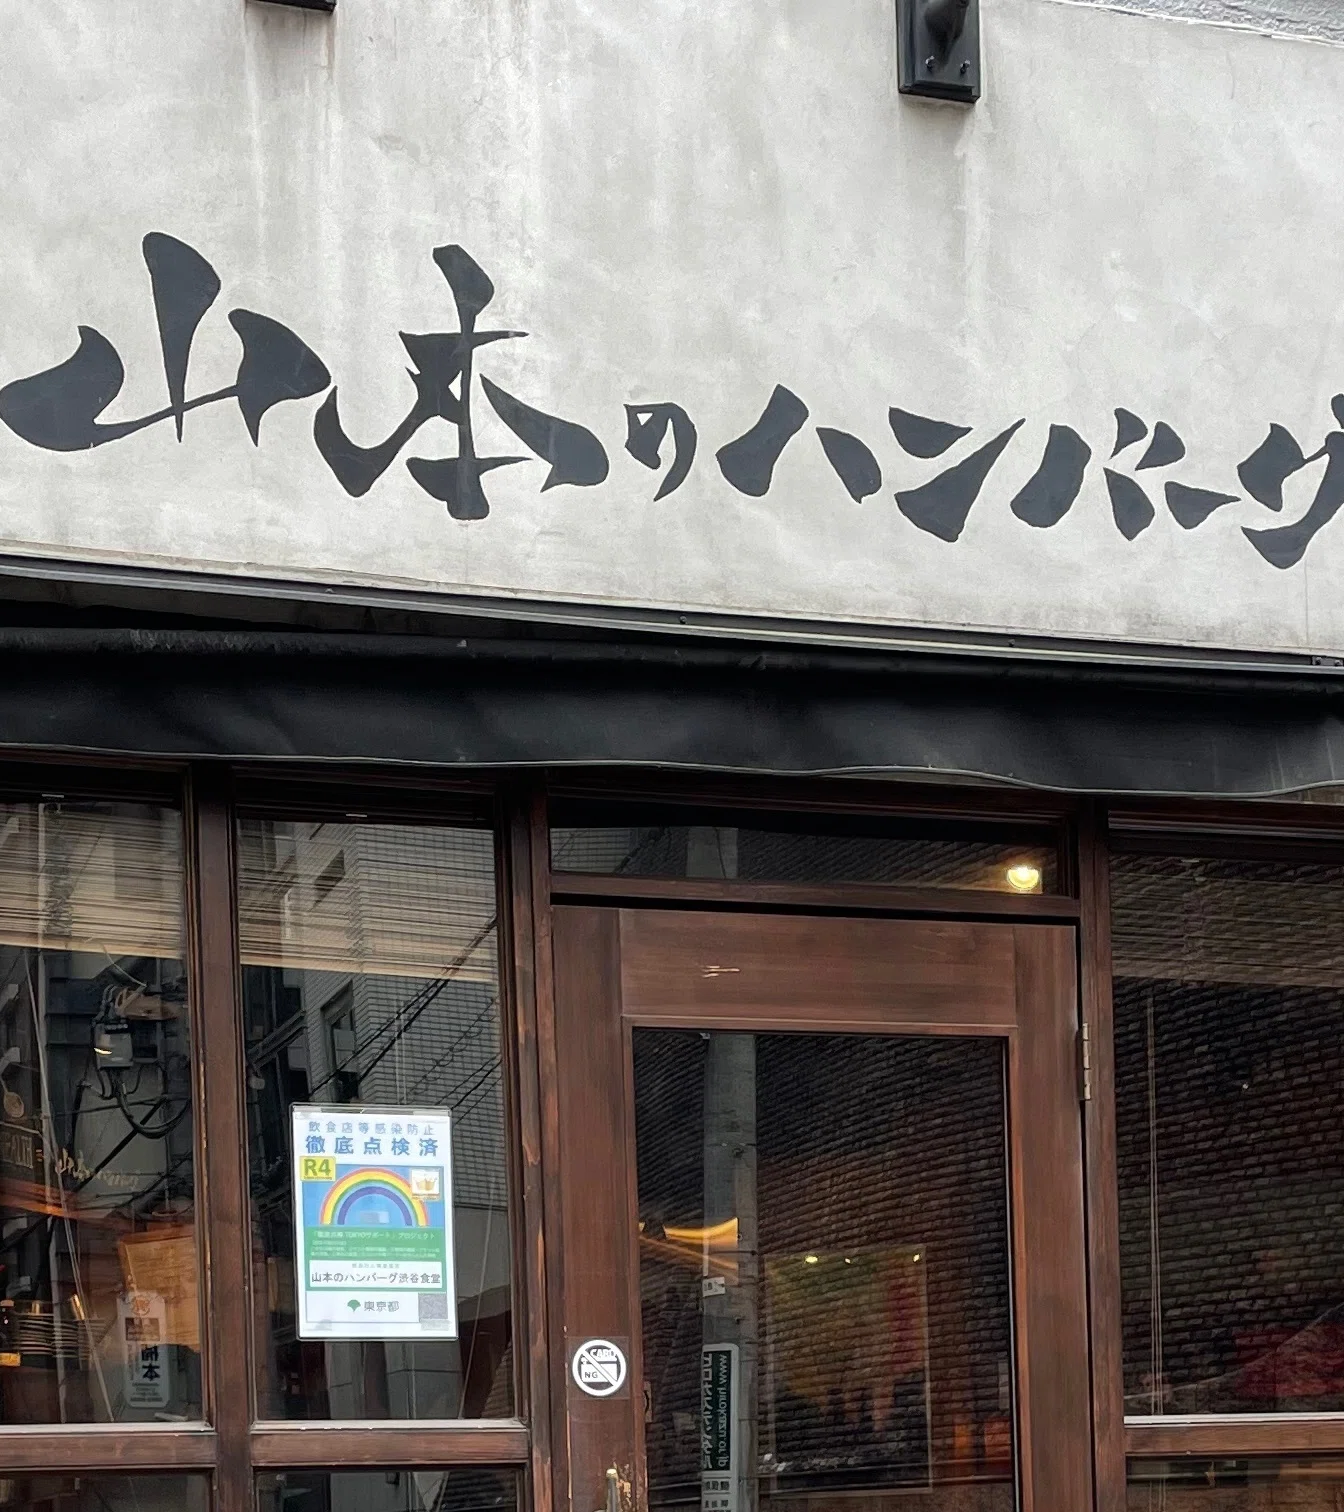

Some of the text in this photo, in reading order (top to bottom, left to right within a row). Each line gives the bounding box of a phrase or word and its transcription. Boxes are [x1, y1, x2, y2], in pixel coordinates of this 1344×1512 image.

[305, 1135, 439, 1157] 徹底点検済
[304, 1158, 332, 1177] R4
[311, 1272, 441, 1284] 山本のハンバーグ渋谷食堂
[364, 1301, 400, 1313] 東京都
